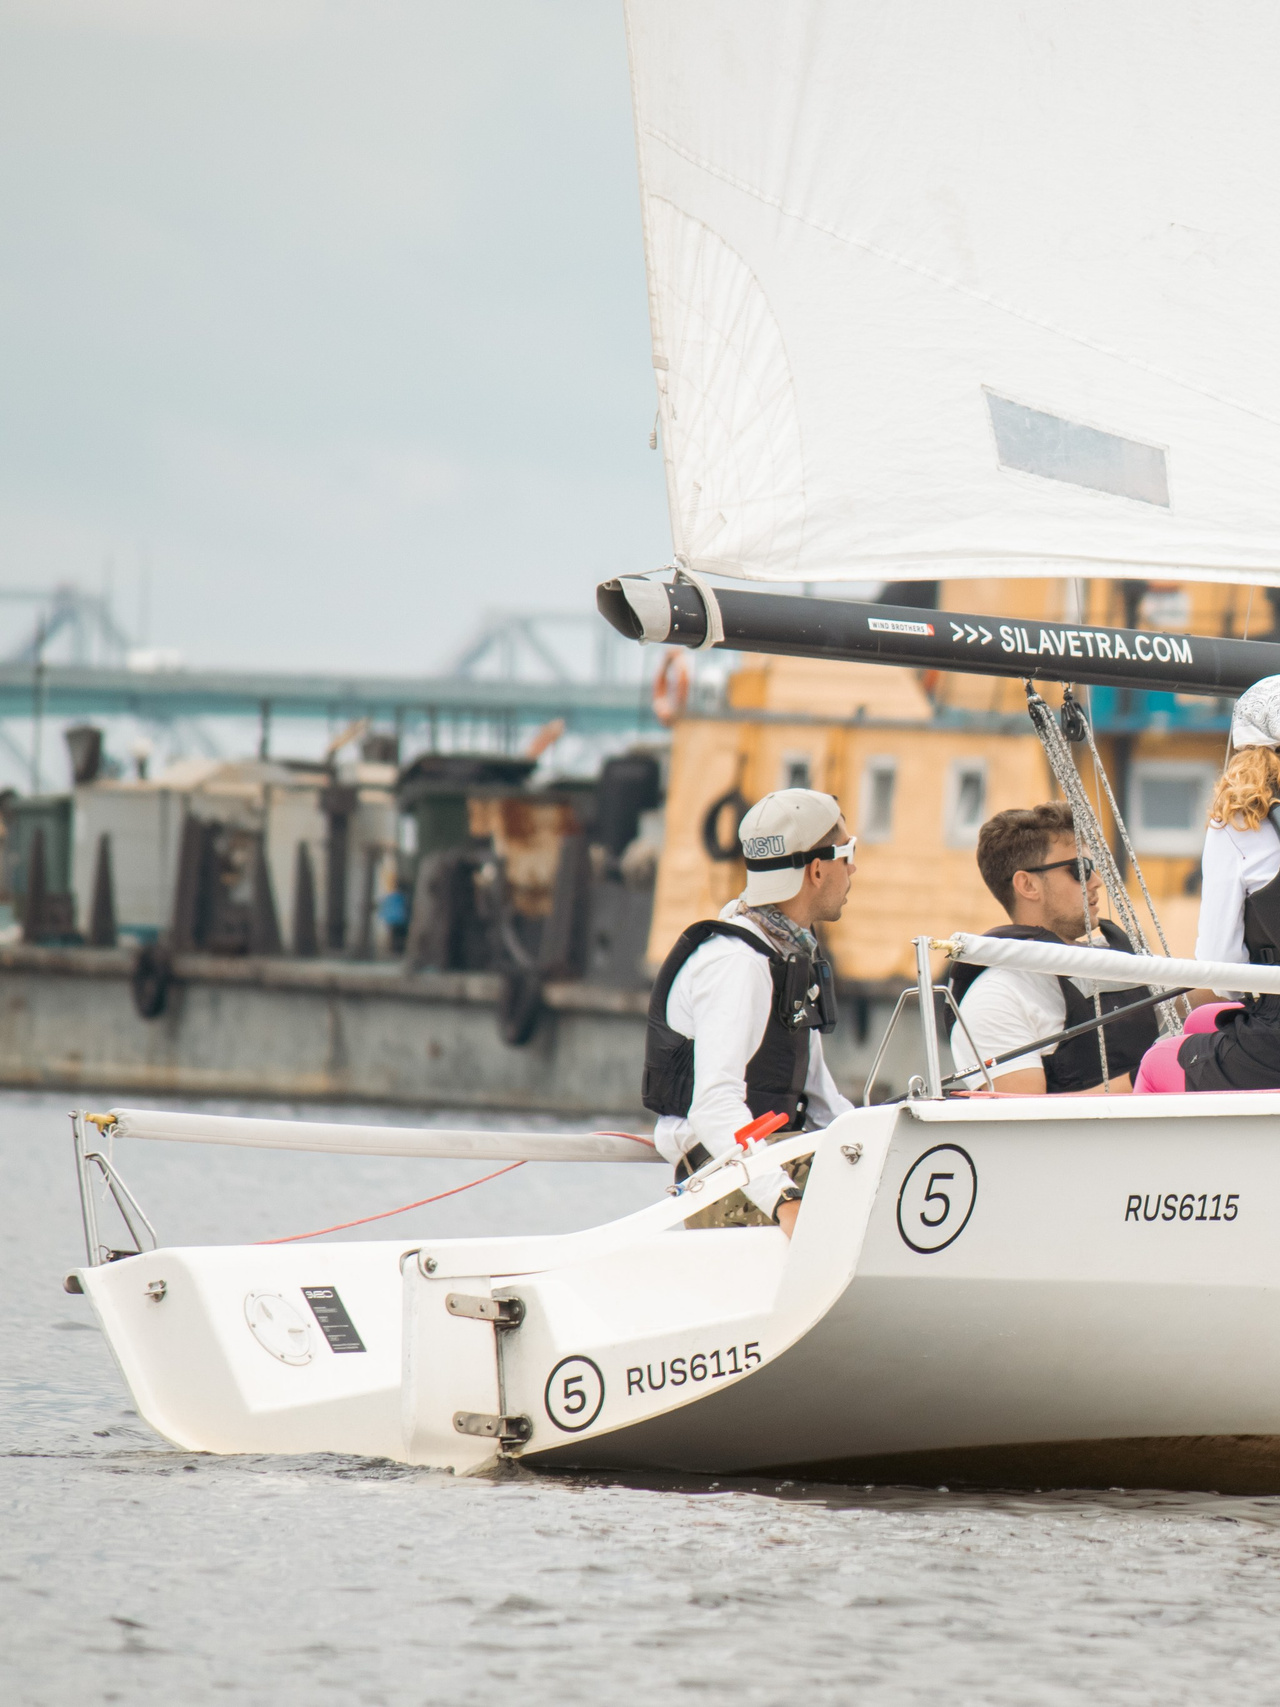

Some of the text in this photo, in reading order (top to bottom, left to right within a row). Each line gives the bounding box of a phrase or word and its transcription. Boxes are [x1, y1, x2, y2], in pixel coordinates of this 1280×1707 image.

[891, 623, 925, 633] BROTHERS
[999, 625, 1193, 664] SILAVETRA.COM
[742, 835, 786, 858] MSU
[920, 1173, 955, 1227] 5
[1124, 1193, 1240, 1222] RUS6115
[626, 1341, 762, 1396] RUS6115
[563, 1375, 587, 1414] 5
